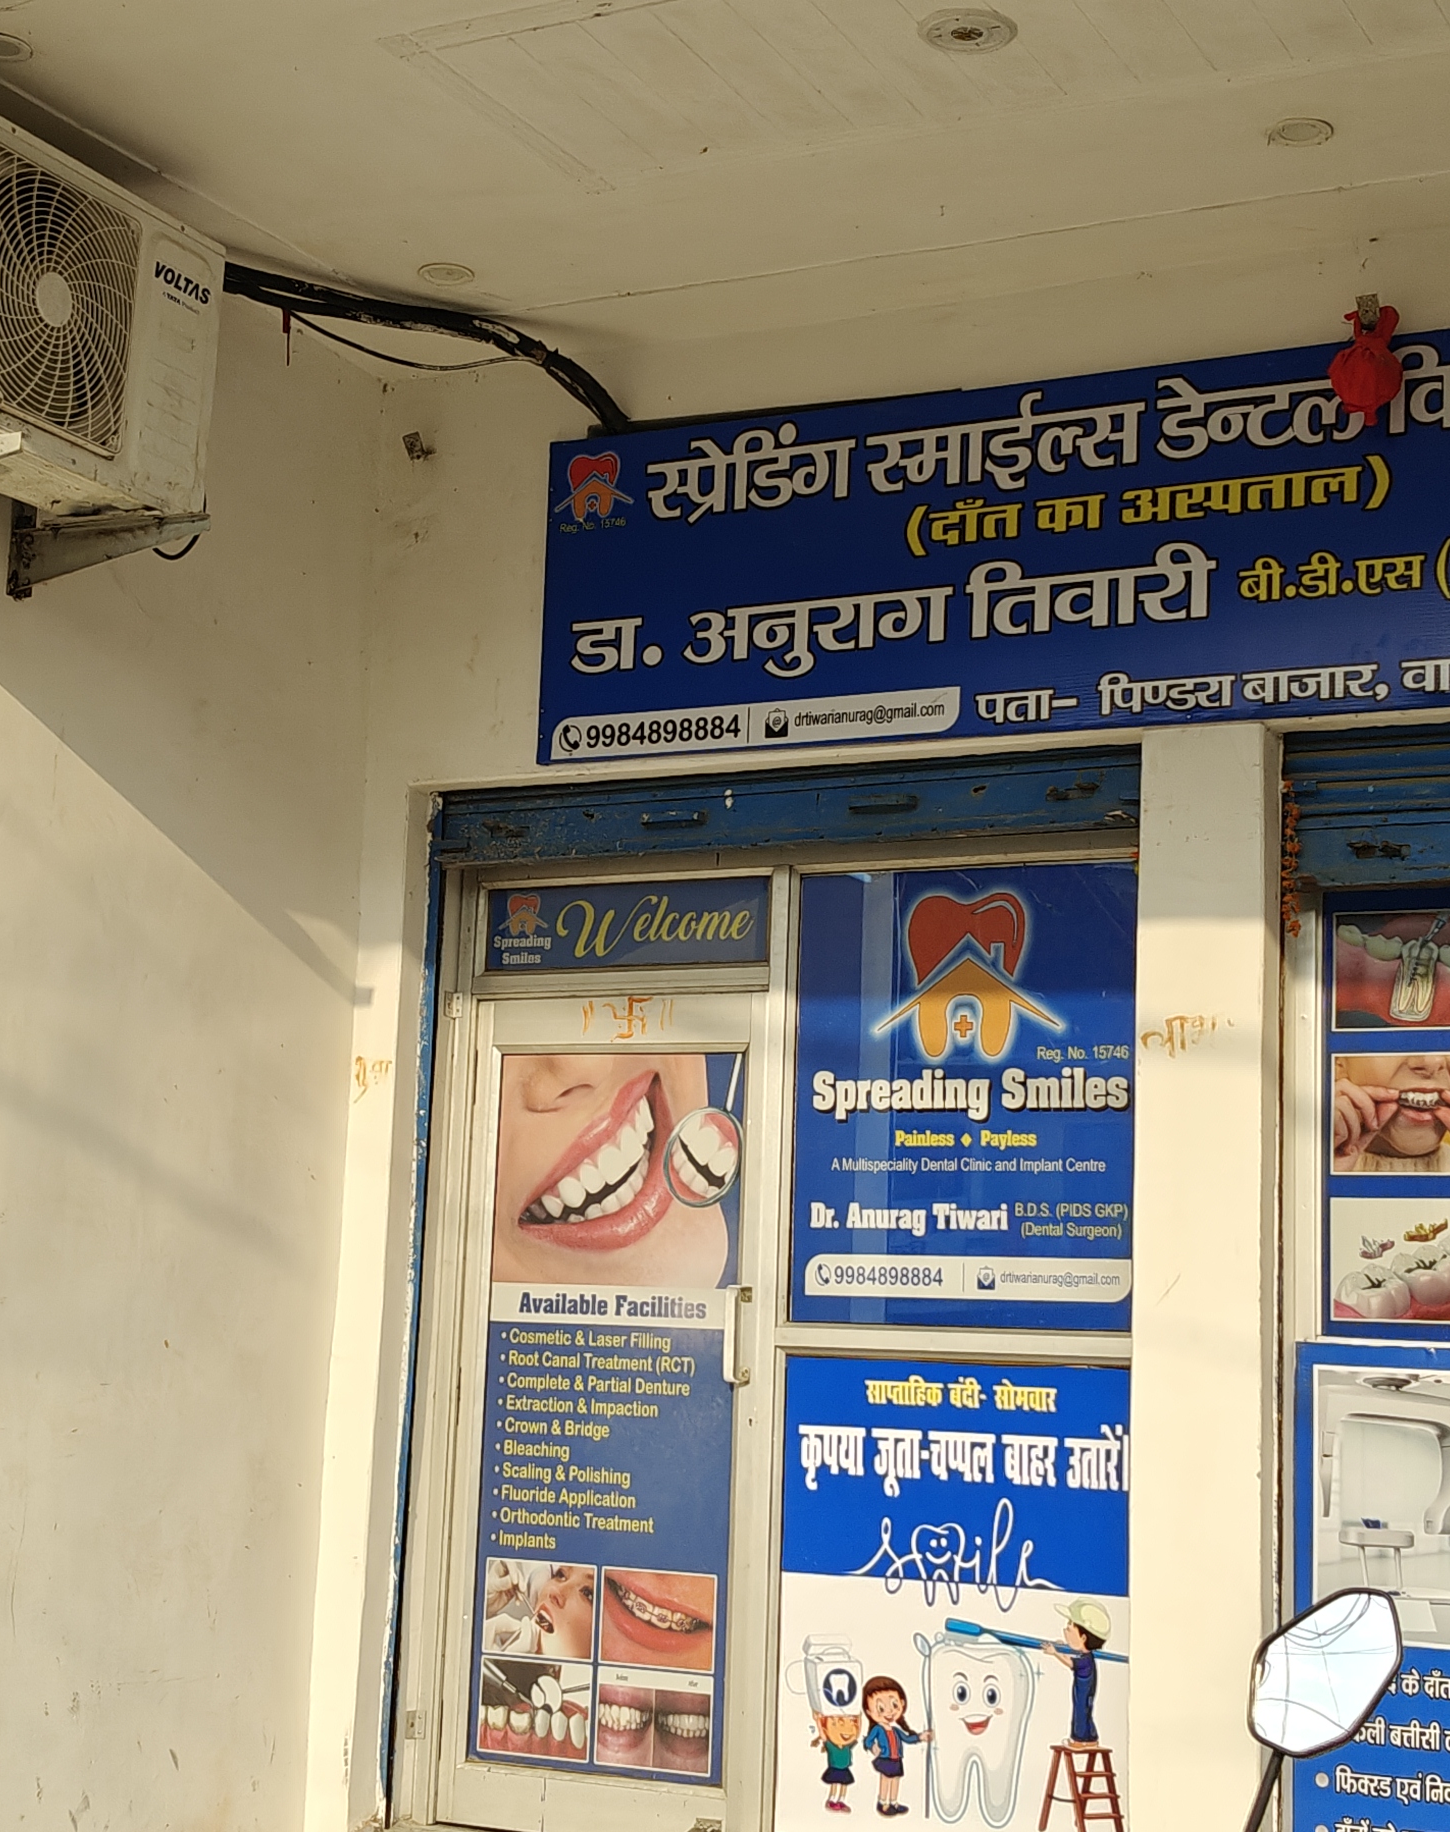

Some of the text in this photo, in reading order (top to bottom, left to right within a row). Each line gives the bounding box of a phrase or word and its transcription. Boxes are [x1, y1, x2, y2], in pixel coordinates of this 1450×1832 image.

[154, 260, 211, 305] VOLTAS
[646, 421, 856, 525] स्प्रेडिंग
[865, 390, 1146, 493] स्माईल्स
[1155, 375, 1367, 460] डेन्टल
[1036, 493, 1106, 534] का
[1121, 454, 1392, 527] अस्पताल)
[570, 616, 664, 674] डा.
[682, 586, 955, 680] अनुराग
[965, 541, 1219, 640] तिवारी
[1238, 551, 1426, 604] बी.डी.एस
[975, 687, 1079, 725] पता-
[1097, 672, 1236, 717] पिण्डरा
[1242, 663, 1389, 704] बाजार,
[794, 702, 945, 728] drtiwarianurag@gmail.com
[585, 714, 742, 749] 9984898884
[555, 894, 755, 959] Welcome
[493, 934, 552, 950] Spreading
[501, 951, 542, 965] Smiles
[1037, 1045, 1130, 1063] Reg. No. 15746
[812, 1067, 1130, 1123] Spreading Smiles
[895, 1130, 1037, 1151] Painless Payless
[831, 1157, 1106, 1174] A Multispeciality Dental Clinic and Implant Centre
[810, 1201, 1009, 1237] Dr. Anurag Tiwari
[1014, 1202, 1129, 1221] B.D.S. (PIDS GKP)
[1020, 1222, 1123, 1240] (Dental Surgeon)
[834, 1265, 944, 1287] 9984898884
[1000, 1271, 1121, 1288] drtiwarianurag@gmail.com
[519, 1291, 707, 1319] Available Facilities
[509, 1328, 672, 1354] Cosmetic & Laser Filling
[508, 1350, 696, 1377] Root Canal Treatment (RCT)
[506, 1372, 691, 1397] Complete & Partial Denture
[864, 1374, 944, 1407] साप्ताहिक
[993, 1378, 1058, 1413] सोमवार
[506, 1395, 659, 1419] Extraction & Impaction
[504, 1417, 611, 1440] Crown & Bridge
[503, 1439, 571, 1461] Bleaching
[798, 1424, 867, 1490] कृपया
[871, 1427, 996, 1498] जूता-चप्पल
[1001, 1434, 1058, 1488] बाहर
[502, 1462, 631, 1489] Scaling & Polishing
[501, 1484, 636, 1509] Fluoride Application
[500, 1506, 654, 1533] Orthodontic Treatment
[498, 1529, 557, 1550] Implants
[1401, 1669, 1421, 1696] के
[1352, 1716, 1386, 1746] कली
[1389, 1718, 1441, 1751] बत्तीसी
[1396, 1772, 1422, 1805] एवं
